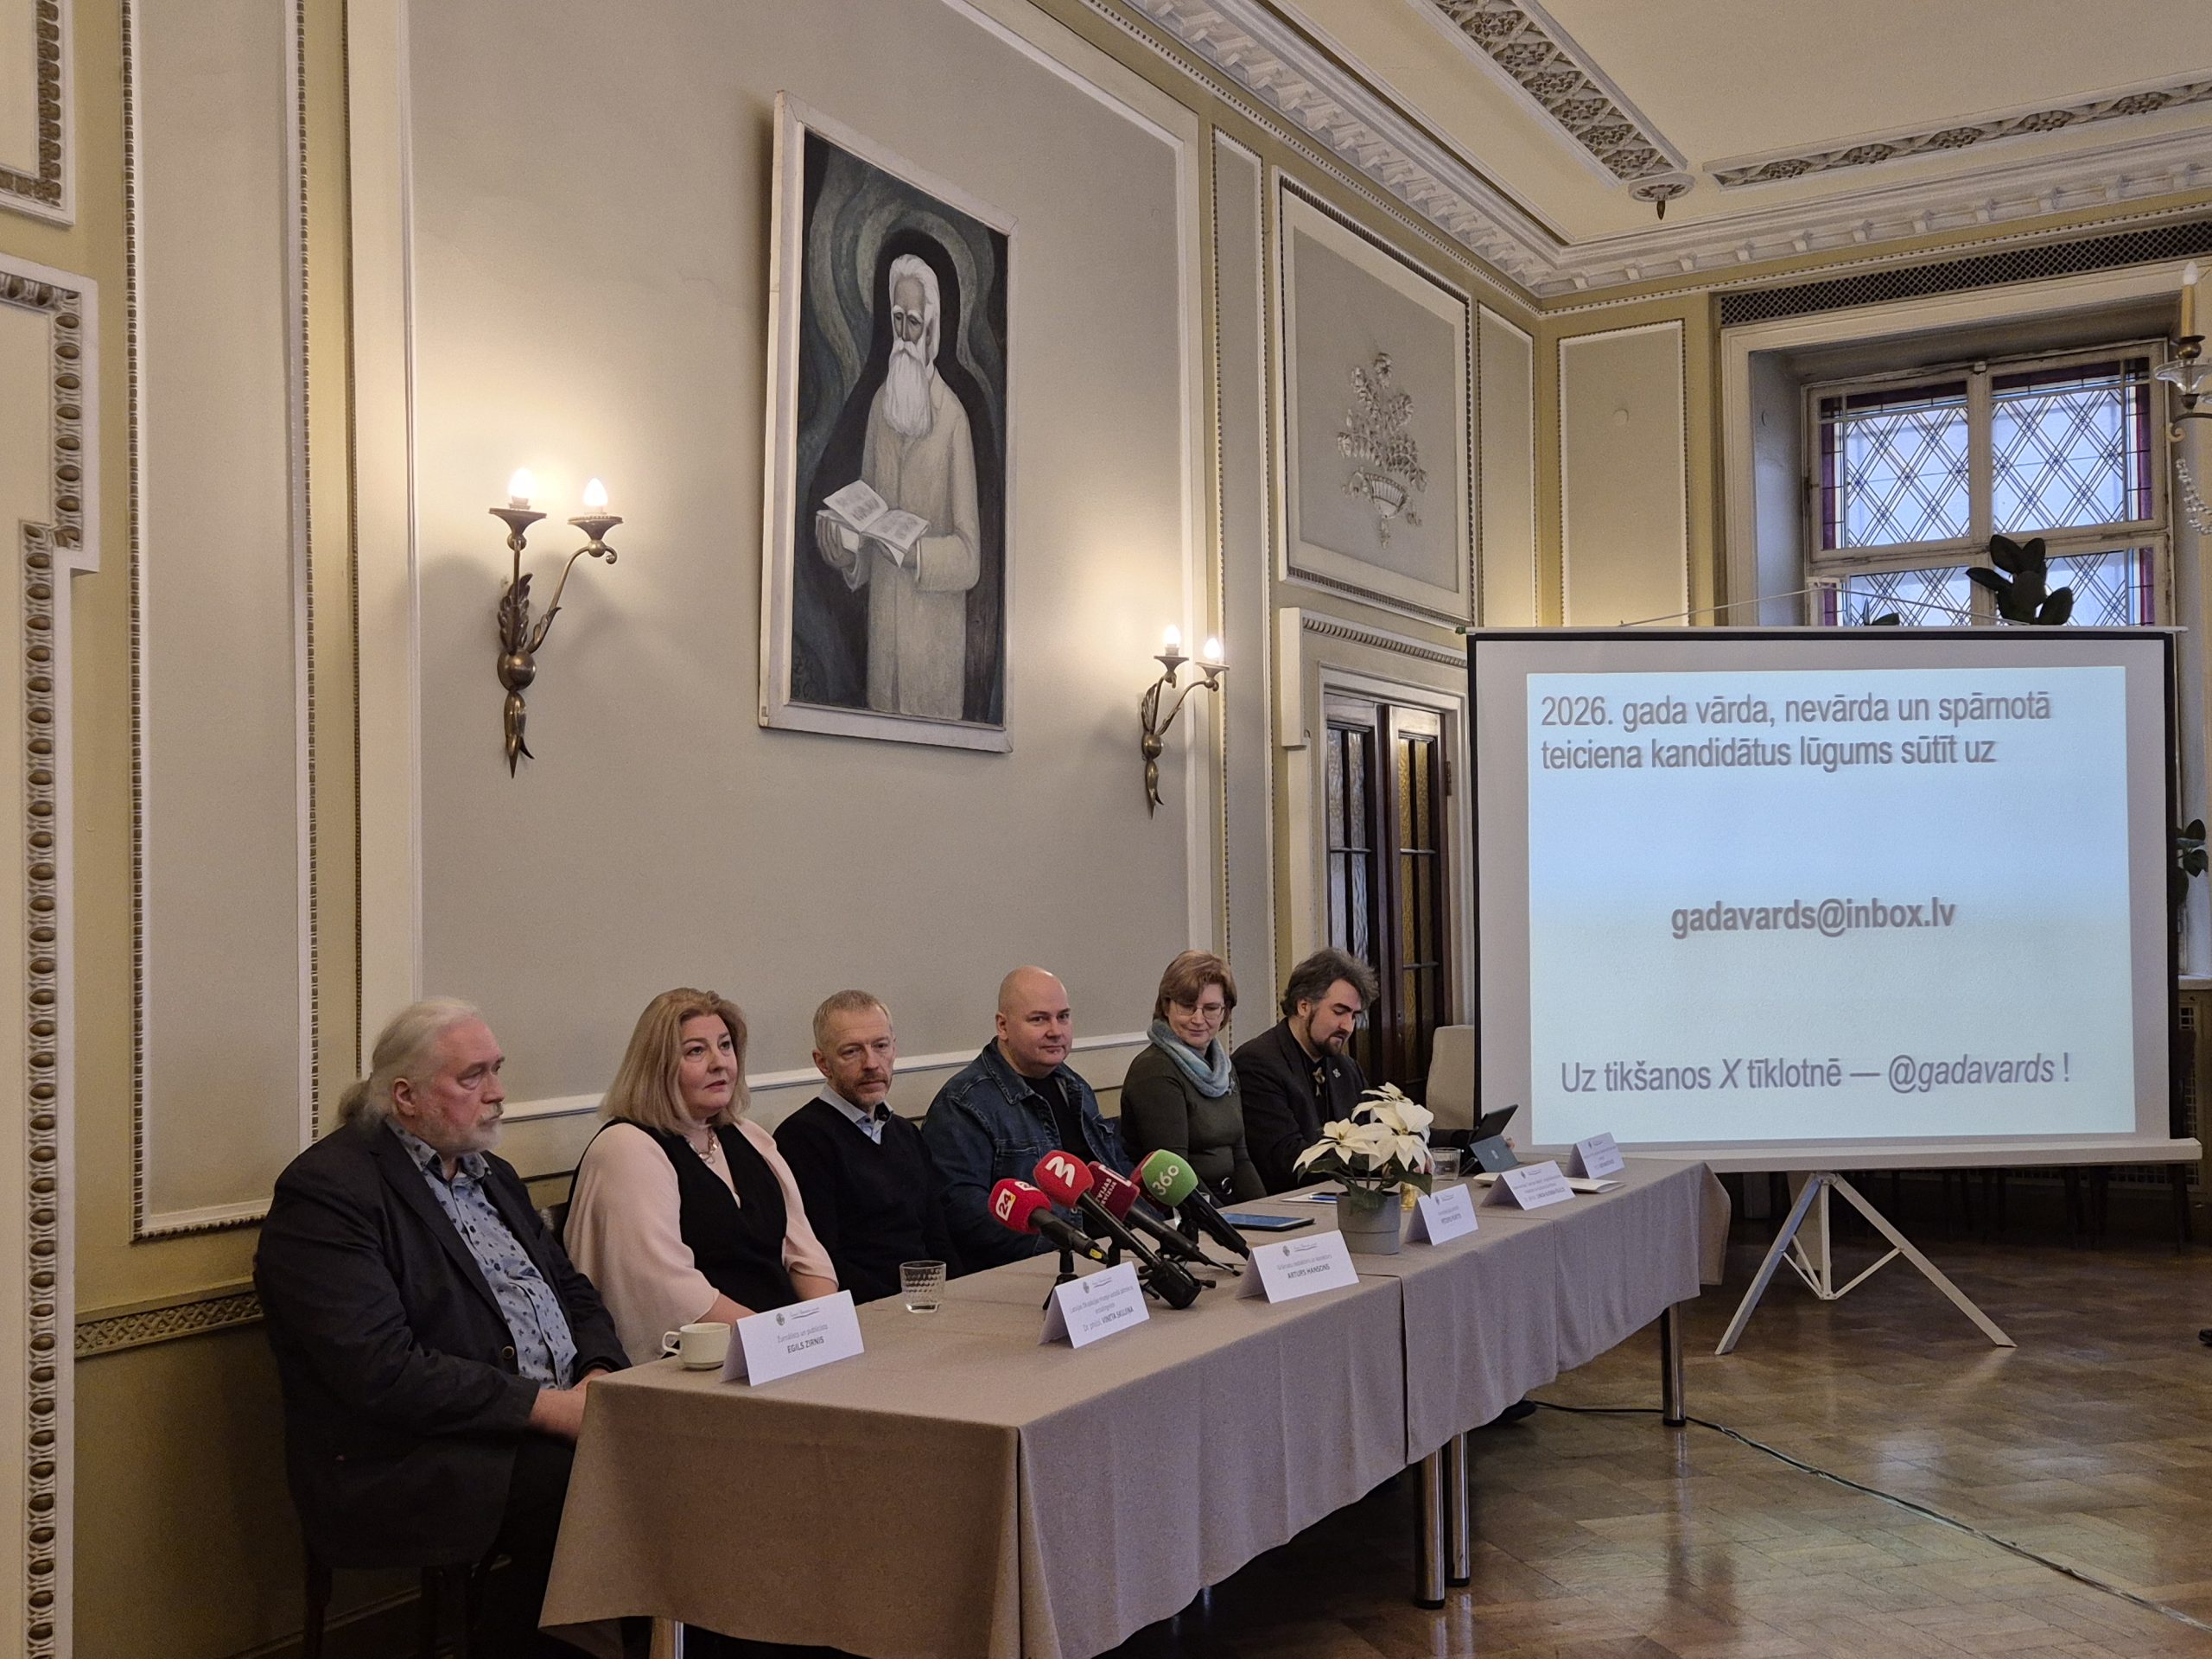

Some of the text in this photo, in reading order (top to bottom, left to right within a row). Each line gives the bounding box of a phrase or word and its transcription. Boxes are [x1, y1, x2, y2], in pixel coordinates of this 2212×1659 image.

[1541, 690, 2050, 733] 2026. gada vārda, nevārda un spārnotā
[1541, 734, 1997, 773] teiciena kandidātus lūgums sūtīt uz
[1671, 896, 1956, 940] gadavards@inbox.lv
[1561, 1062, 1597, 1093] Uz
[1604, 1060, 1712, 1091] tikšanos
[1718, 1058, 1742, 1089] X
[1747, 1058, 1842, 1089] tīklotnē
[1889, 1052, 2055, 1094] @gadavards
[1152, 1165, 1179, 1196] 360
[999, 1193, 1012, 1216] 24
[787, 1341, 804, 1354] EGILS
